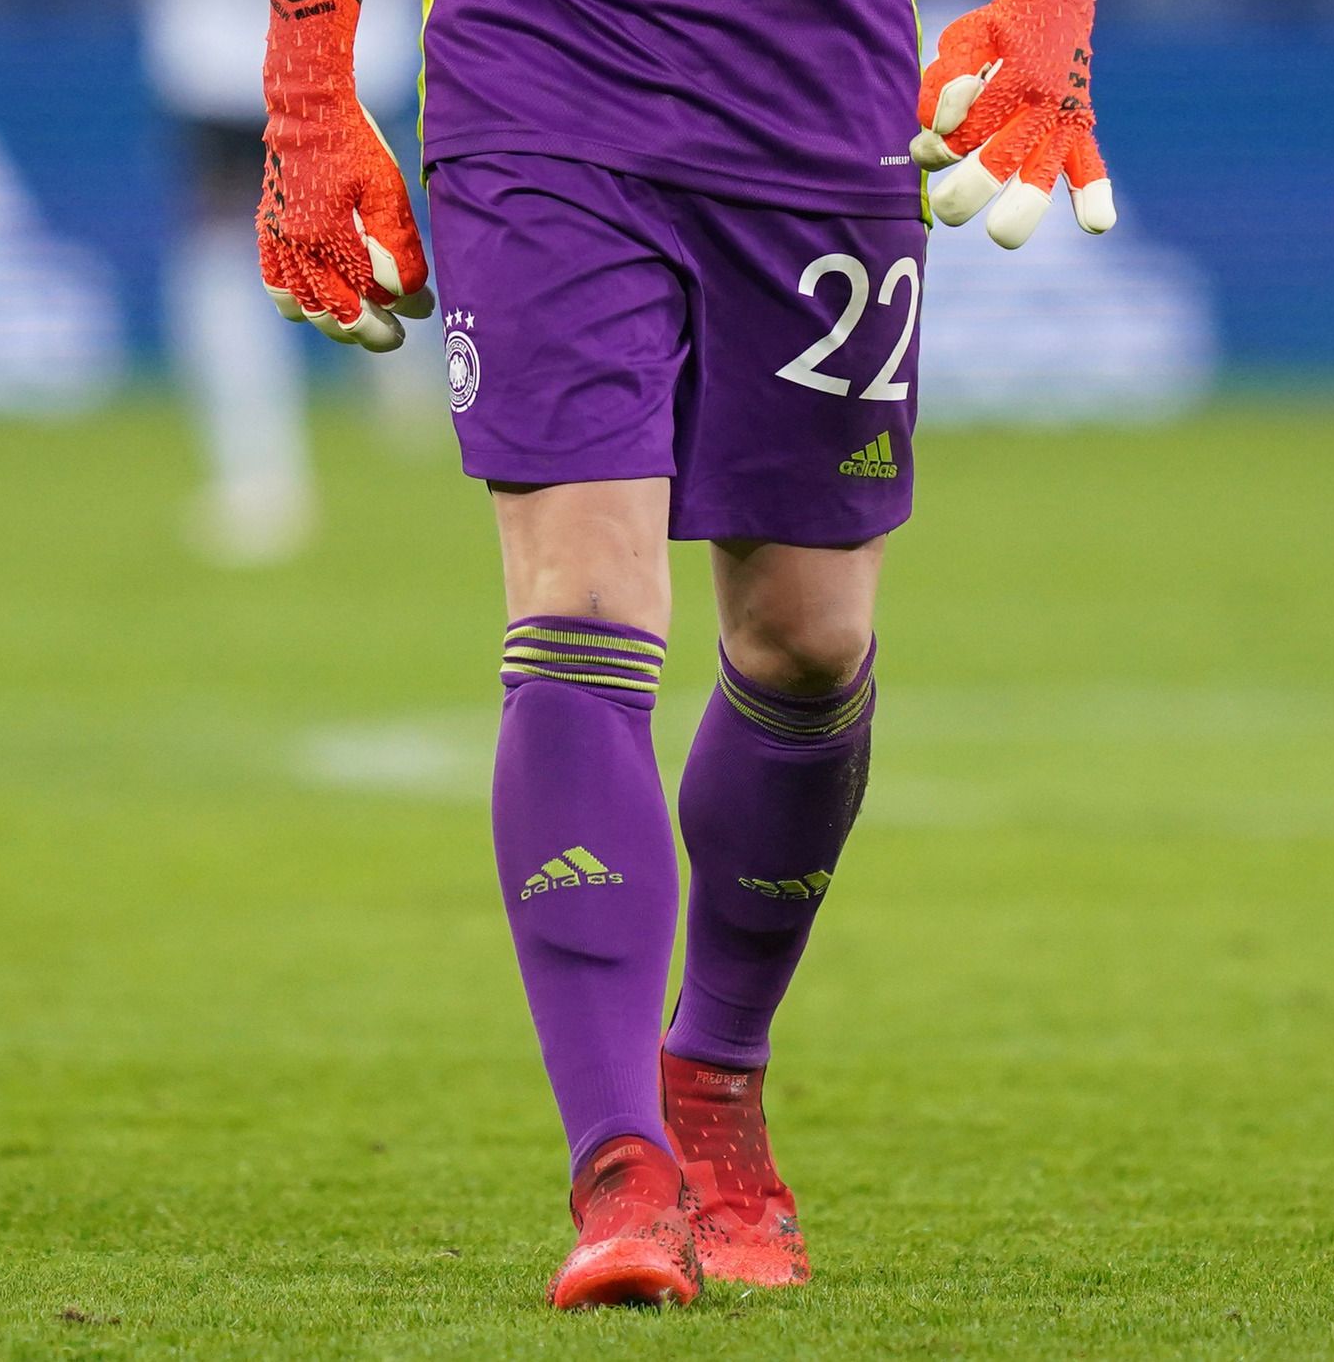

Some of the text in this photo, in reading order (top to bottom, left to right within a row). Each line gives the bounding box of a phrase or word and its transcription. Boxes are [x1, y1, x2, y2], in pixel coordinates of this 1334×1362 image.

[774, 253, 919, 401] 22
[838, 460, 898, 479] adidas
[520, 873, 624, 900] adidas
